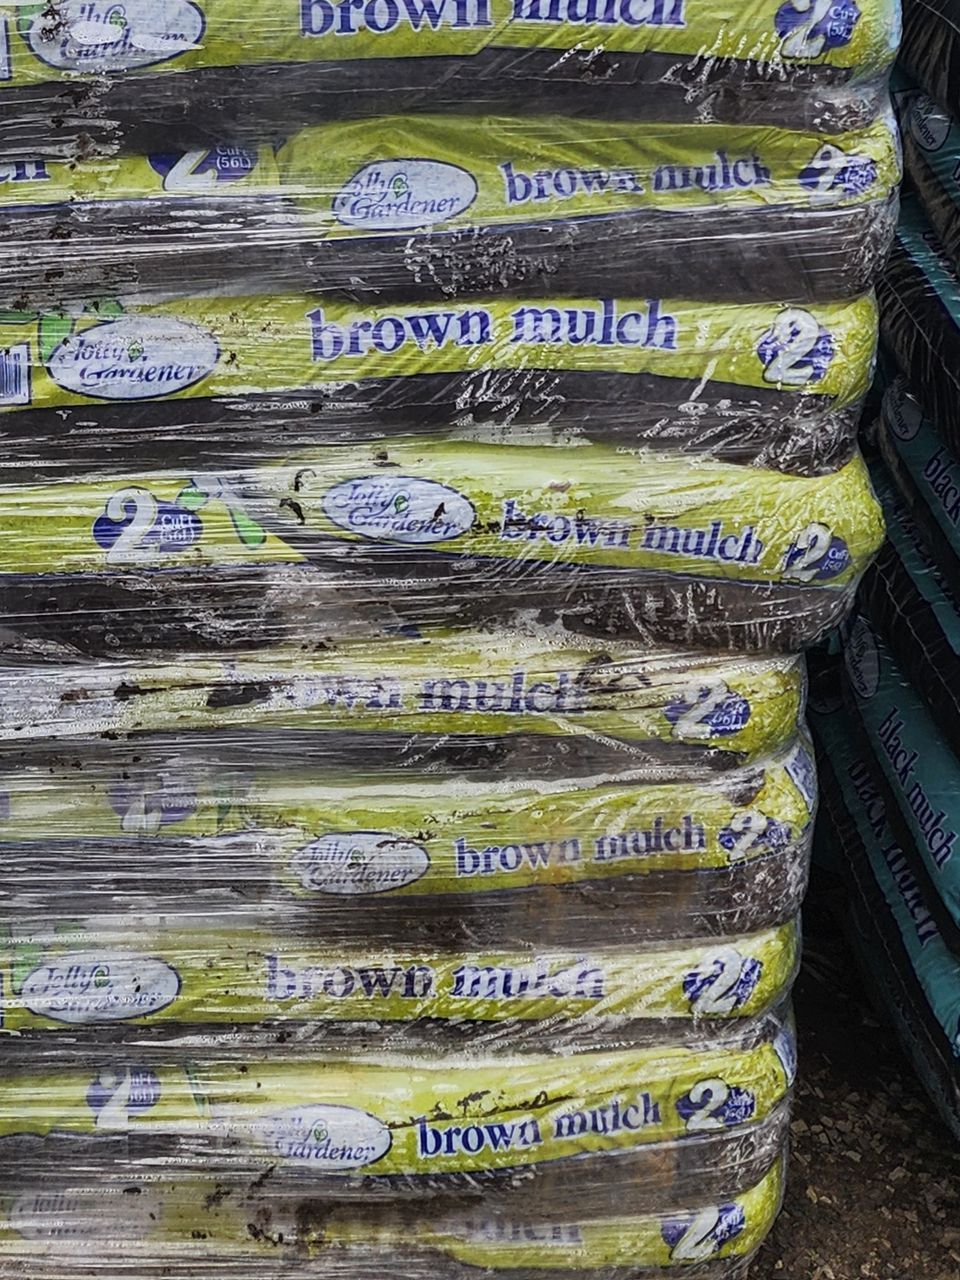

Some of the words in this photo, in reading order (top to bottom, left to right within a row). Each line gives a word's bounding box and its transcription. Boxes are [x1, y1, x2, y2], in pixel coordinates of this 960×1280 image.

[215, 155, 252, 171] (56L)
[500, 162, 645, 205] brown
[349, 193, 461, 220] Gardener
[305, 306, 495, 362] brown
[511, 299, 678, 350] mulch
[763, 306, 820, 386] 2
[104, 485, 159, 563] 2
[640, 520, 763, 564] mulch
[781, 521, 834, 582] 2
[876, 707, 919, 790] black
[905, 779, 959, 870] mulch
[309, 863, 416, 888] Gardener
[454, 836, 581, 877] brown
[594, 814, 707, 862] mulch
[691, 943, 743, 1015] 2
[417, 1115, 544, 1158] brown
[552, 1092, 663, 1139] mulch
[686, 1077, 730, 1131] 2
[276, 1138, 377, 1161] ardener
